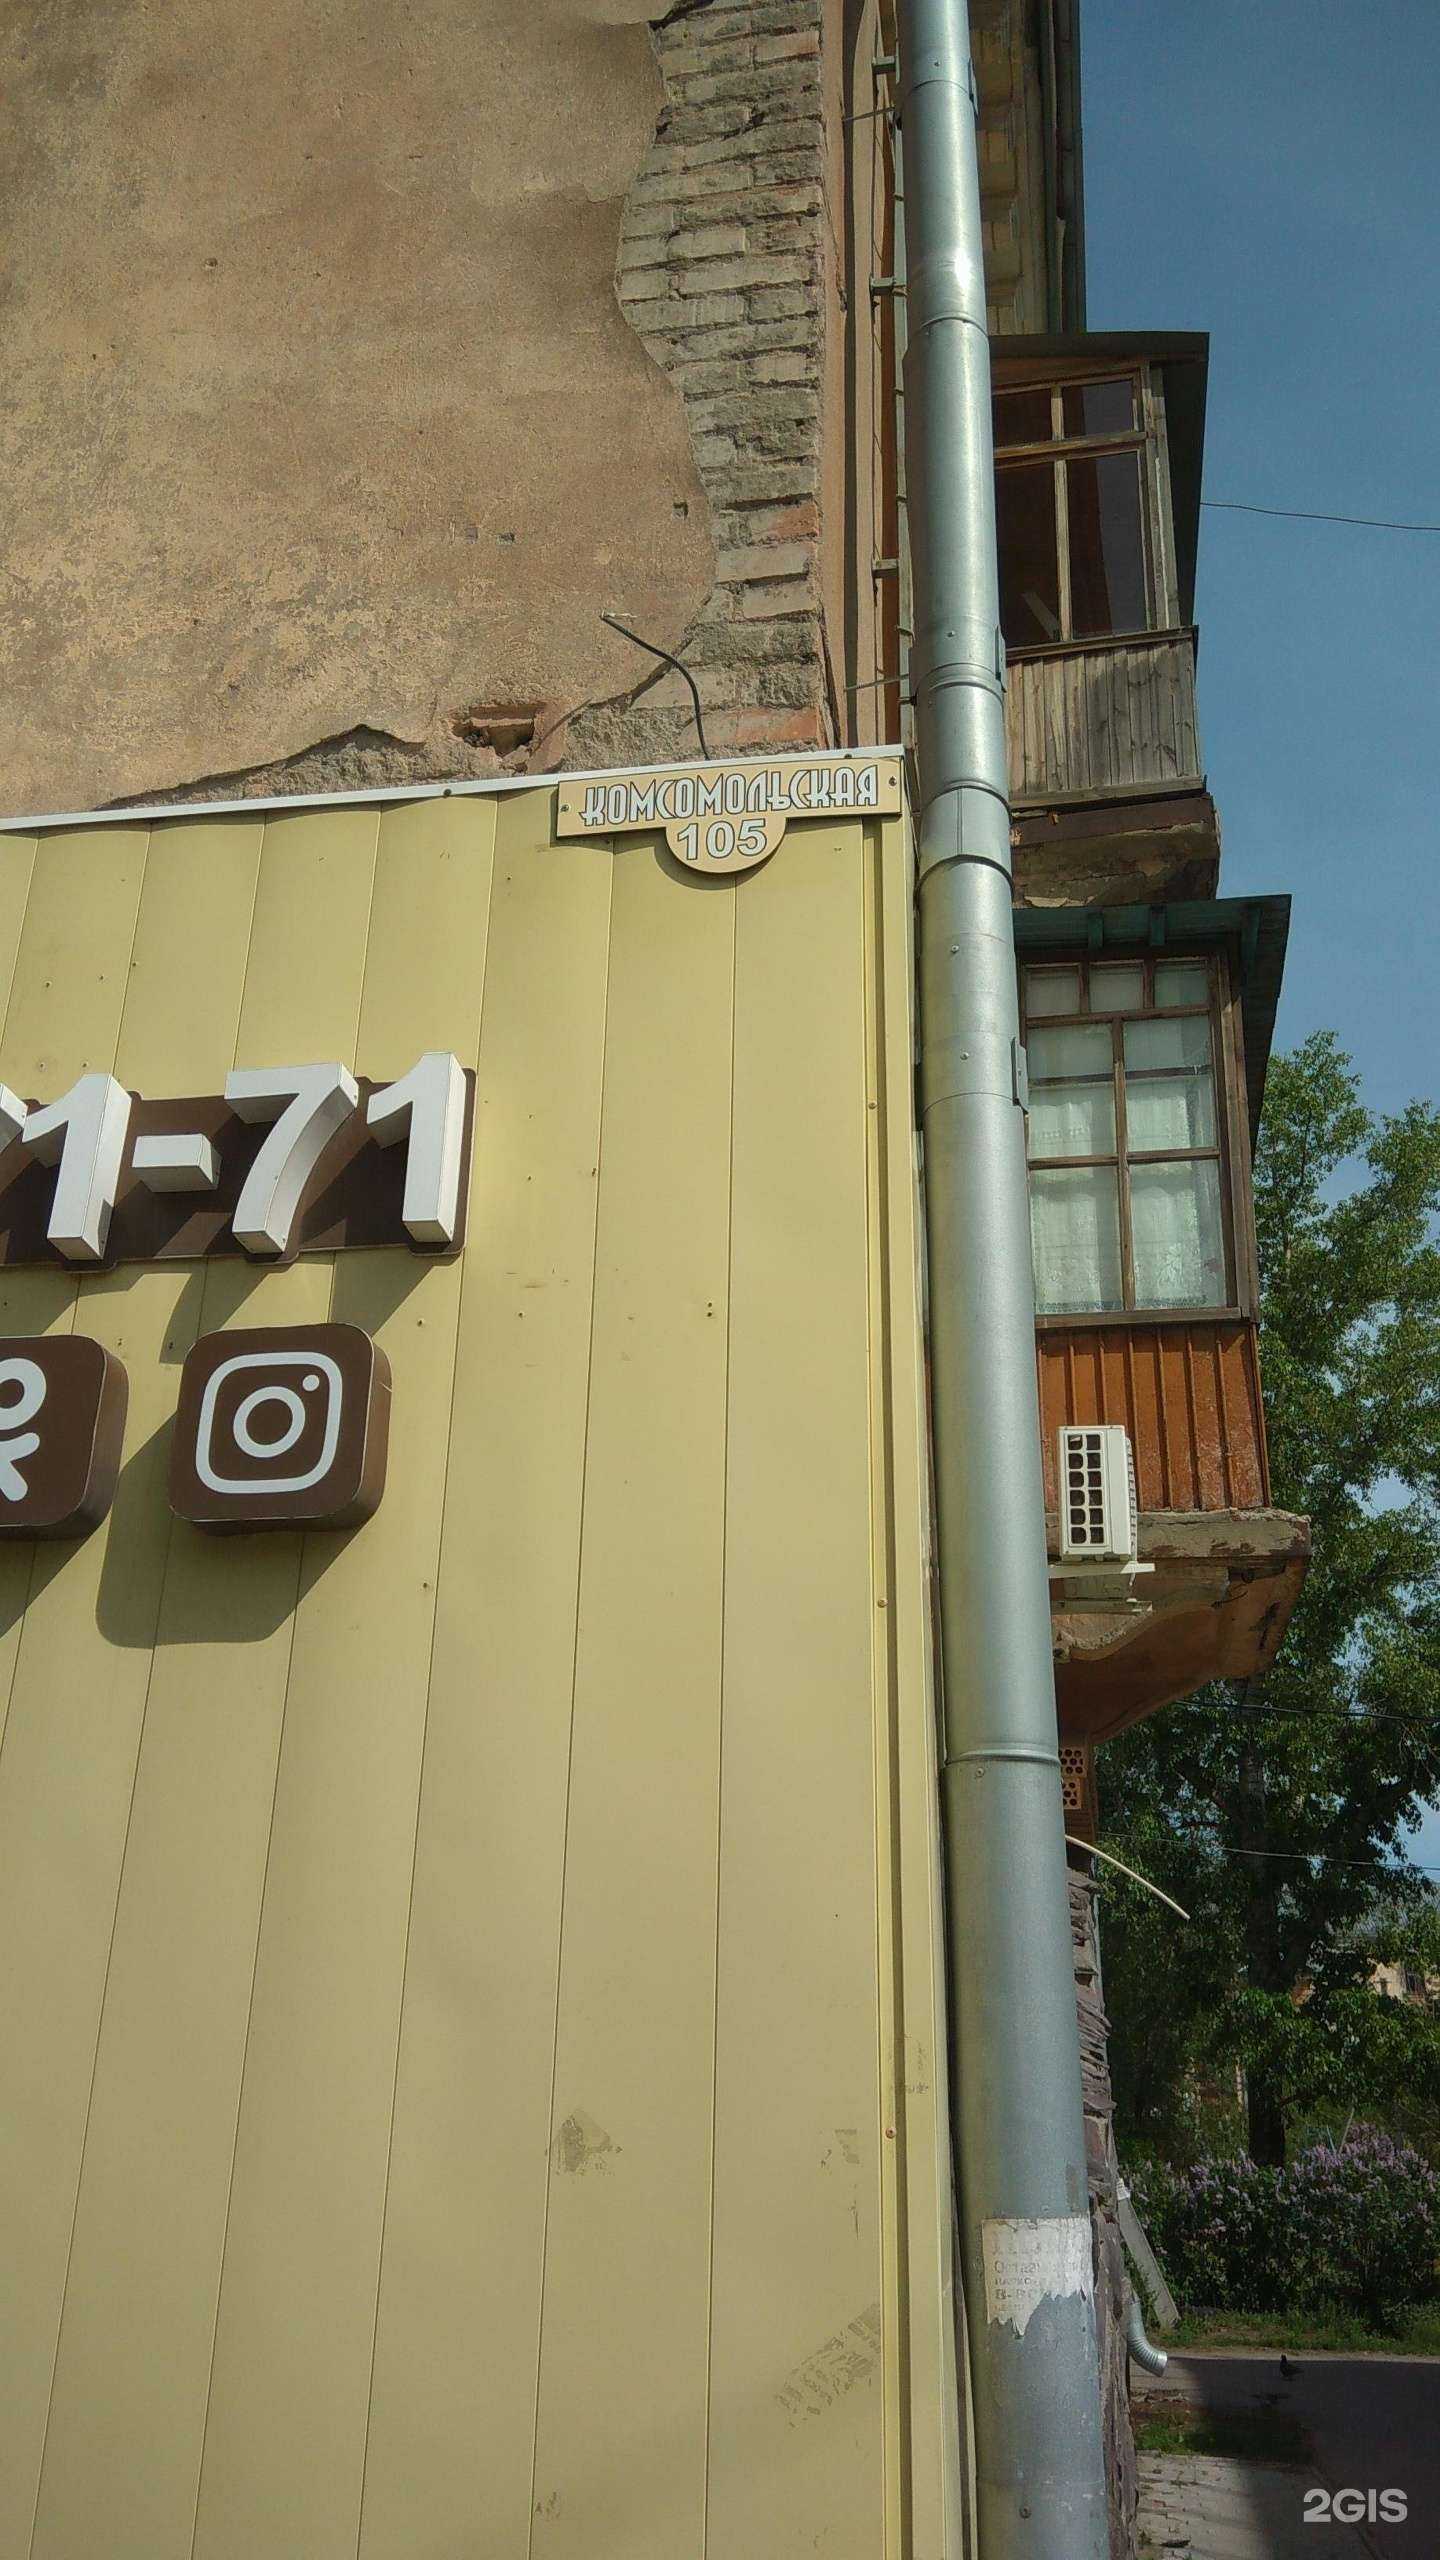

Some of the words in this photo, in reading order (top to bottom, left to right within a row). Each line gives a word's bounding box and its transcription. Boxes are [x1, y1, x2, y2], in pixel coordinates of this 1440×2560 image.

[580, 765, 878, 826] КОМСОМОЛЬСКАЯ
[677, 818, 767, 861] 105
[0, 1052, 466, 1260] 1-71
